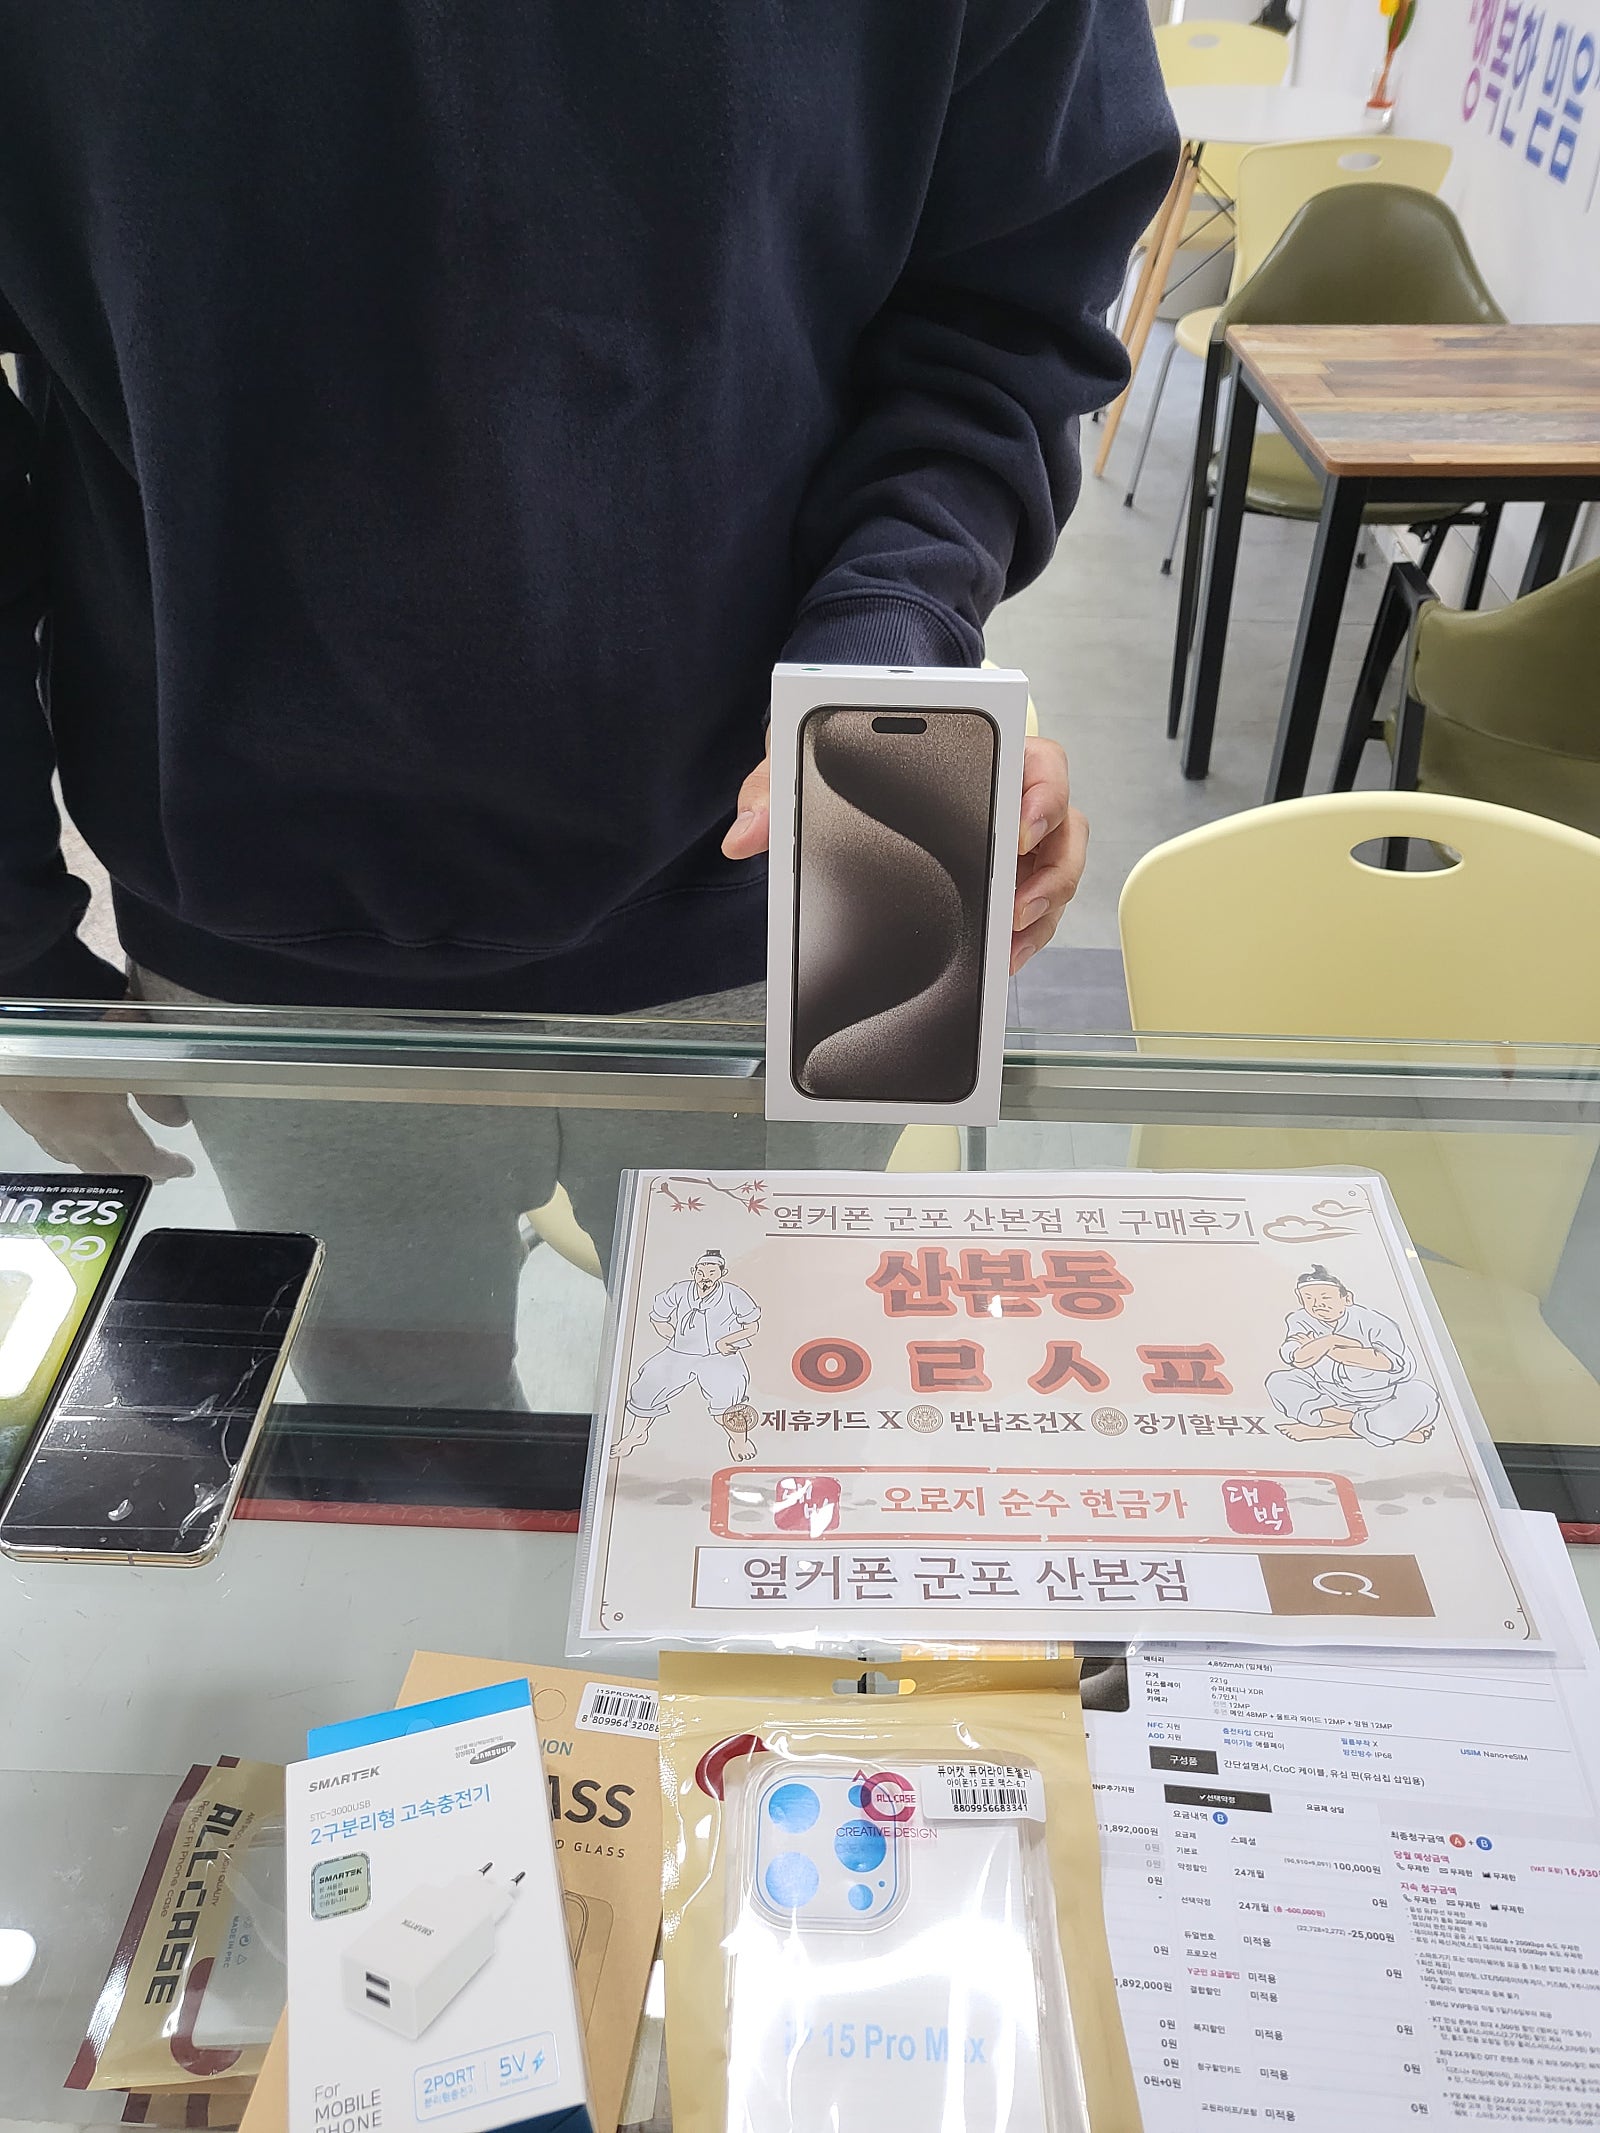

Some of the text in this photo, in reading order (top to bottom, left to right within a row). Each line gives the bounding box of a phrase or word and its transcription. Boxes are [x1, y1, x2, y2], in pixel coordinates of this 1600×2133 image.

[1525, 22, 1595, 185] 믿음
[47, 1199, 124, 1226] S23
[772, 1204, 1257, 1238] 옆커폰 군포 산본점 찐 구매후기
[865, 1246, 1135, 1321] 산본동
[759, 1408, 870, 1432] 제휴카드
[877, 1410, 904, 1430] X
[880, 1485, 1188, 1520] 오로지 순수 현금가
[742, 1554, 1188, 1602] 옆커폰 군포 산본점
[1145, 1680, 1181, 1689] 디스플레이
[1247, 1688, 1264, 1696] XDR
[1209, 1676, 1228, 1685] 221g
[581, 1714, 589, 1723] 8
[592, 1715, 628, 1728] 809964
[1146, 1721, 1164, 1730] NFC
[1166, 1722, 1181, 1731] 지원
[1324, 1717, 1346, 1727] 12MP
[1370, 1721, 1393, 1730] 12MP
[1147, 1732, 1165, 1741] AOD
[1167, 1733, 1182, 1742] 지원
[1374, 1751, 1393, 1760] IP68
[1459, 1748, 1482, 1758] USIM
[1169, 1754, 1199, 1766] 구성품
[308, 1765, 381, 1793] SMARTEK
[946, 1778, 978, 1788] 아이폰15
[980, 1778, 996, 1787] 프로
[310, 1784, 491, 1846] 2구분리형 고속충전기
[953, 1804, 1028, 1813] 8809956683341
[835, 1826, 938, 1839] CREATIVE DESIGN
[1104, 1824, 1159, 1837] 1,892,000원
[1174, 1830, 1197, 1840] 요금제
[1229, 1836, 1257, 1847] 스페셜
[574, 1841, 626, 1859] GLASS
[319, 1866, 363, 1884] SMARTEK
[1234, 1868, 1266, 1880] 24개월
[1333, 1862, 1382, 1875] 100,000원
[1147, 1876, 1164, 1887] 0원
[1238, 1901, 1270, 1914] 24개월
[1372, 1898, 1388, 1908] 0원
[1243, 1935, 1272, 1948] 미적용
[1153, 1945, 1170, 1956] 0원
[1385, 1968, 1403, 1980] 0원
[1248, 1972, 1277, 1984] 미적용
[1249, 1991, 1279, 2003] 미적용
[1159, 2019, 1176, 2030] 0원
[1255, 2028, 1283, 2041] 미적용
[1396, 2024, 1414, 2036] 0원
[823, 2021, 986, 2064] 15 Pro Mx
[1161, 2038, 1178, 2050] 0원
[423, 2065, 476, 2094] 2PORT
[500, 2051, 526, 2078] 5V
[1163, 2058, 1180, 2069] 0원
[1260, 2068, 1289, 2081] 미적용
[1403, 2063, 1422, 2075] 0원
[1143, 2075, 1182, 2089] 0원+0원
[314, 2082, 341, 2103] For
[315, 2088, 382, 2124] MOBILE
[1265, 2103, 1429, 2122] 미적용 0원
